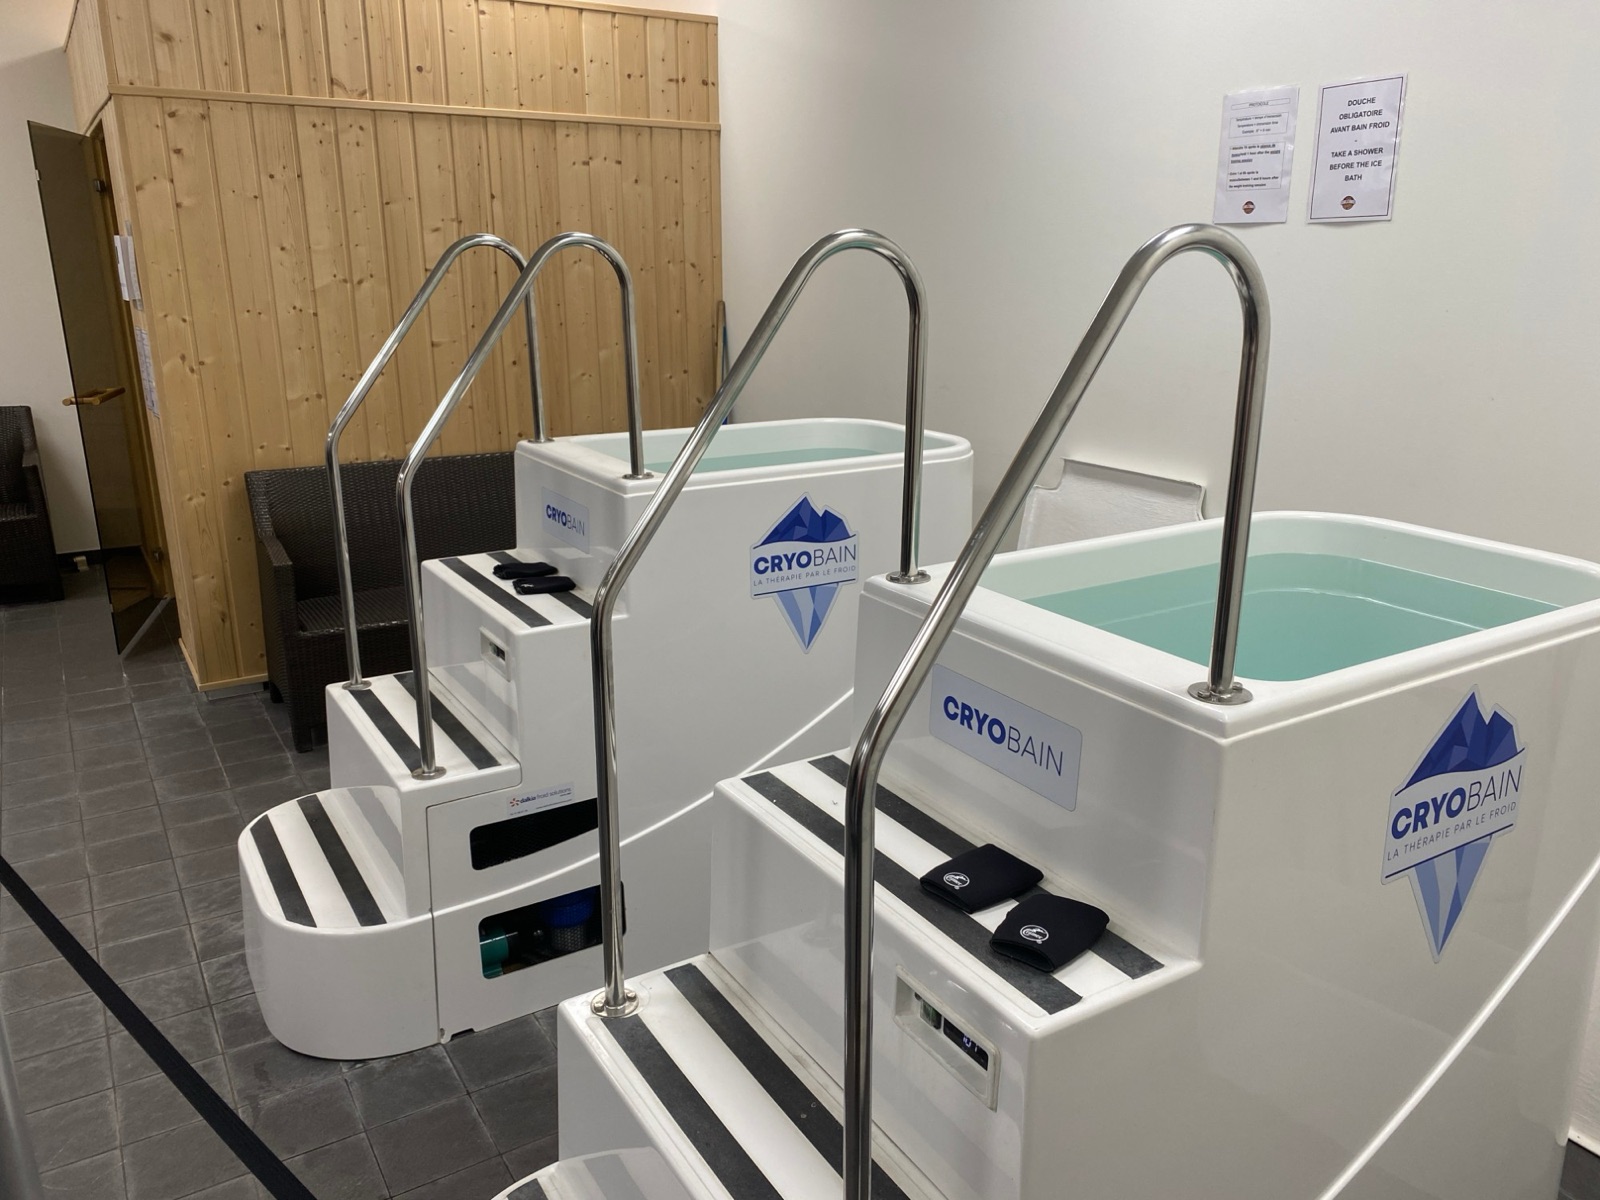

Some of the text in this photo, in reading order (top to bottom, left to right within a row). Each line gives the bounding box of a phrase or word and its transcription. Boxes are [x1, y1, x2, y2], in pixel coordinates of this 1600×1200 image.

[1348, 97, 1376, 106] DOUCHE
[1339, 109, 1383, 120] OBLIGATOIRE
[1330, 125, 1350, 134] AVANT
[1369, 121, 1390, 129] FROID
[1354, 147, 1383, 156] SHOWER
[1330, 162, 1354, 170] BEFORE
[546, 504, 584, 536] CRYOBAIN
[754, 544, 856, 575] CRYOBAIN
[766, 573, 802, 584] THÉRAPIE
[943, 695, 1063, 776] CRYOBAIN
[1391, 765, 1522, 840] CRYOBAIN
[1388, 801, 1517, 861] LA THÉRAPIE PAR LE FROID
